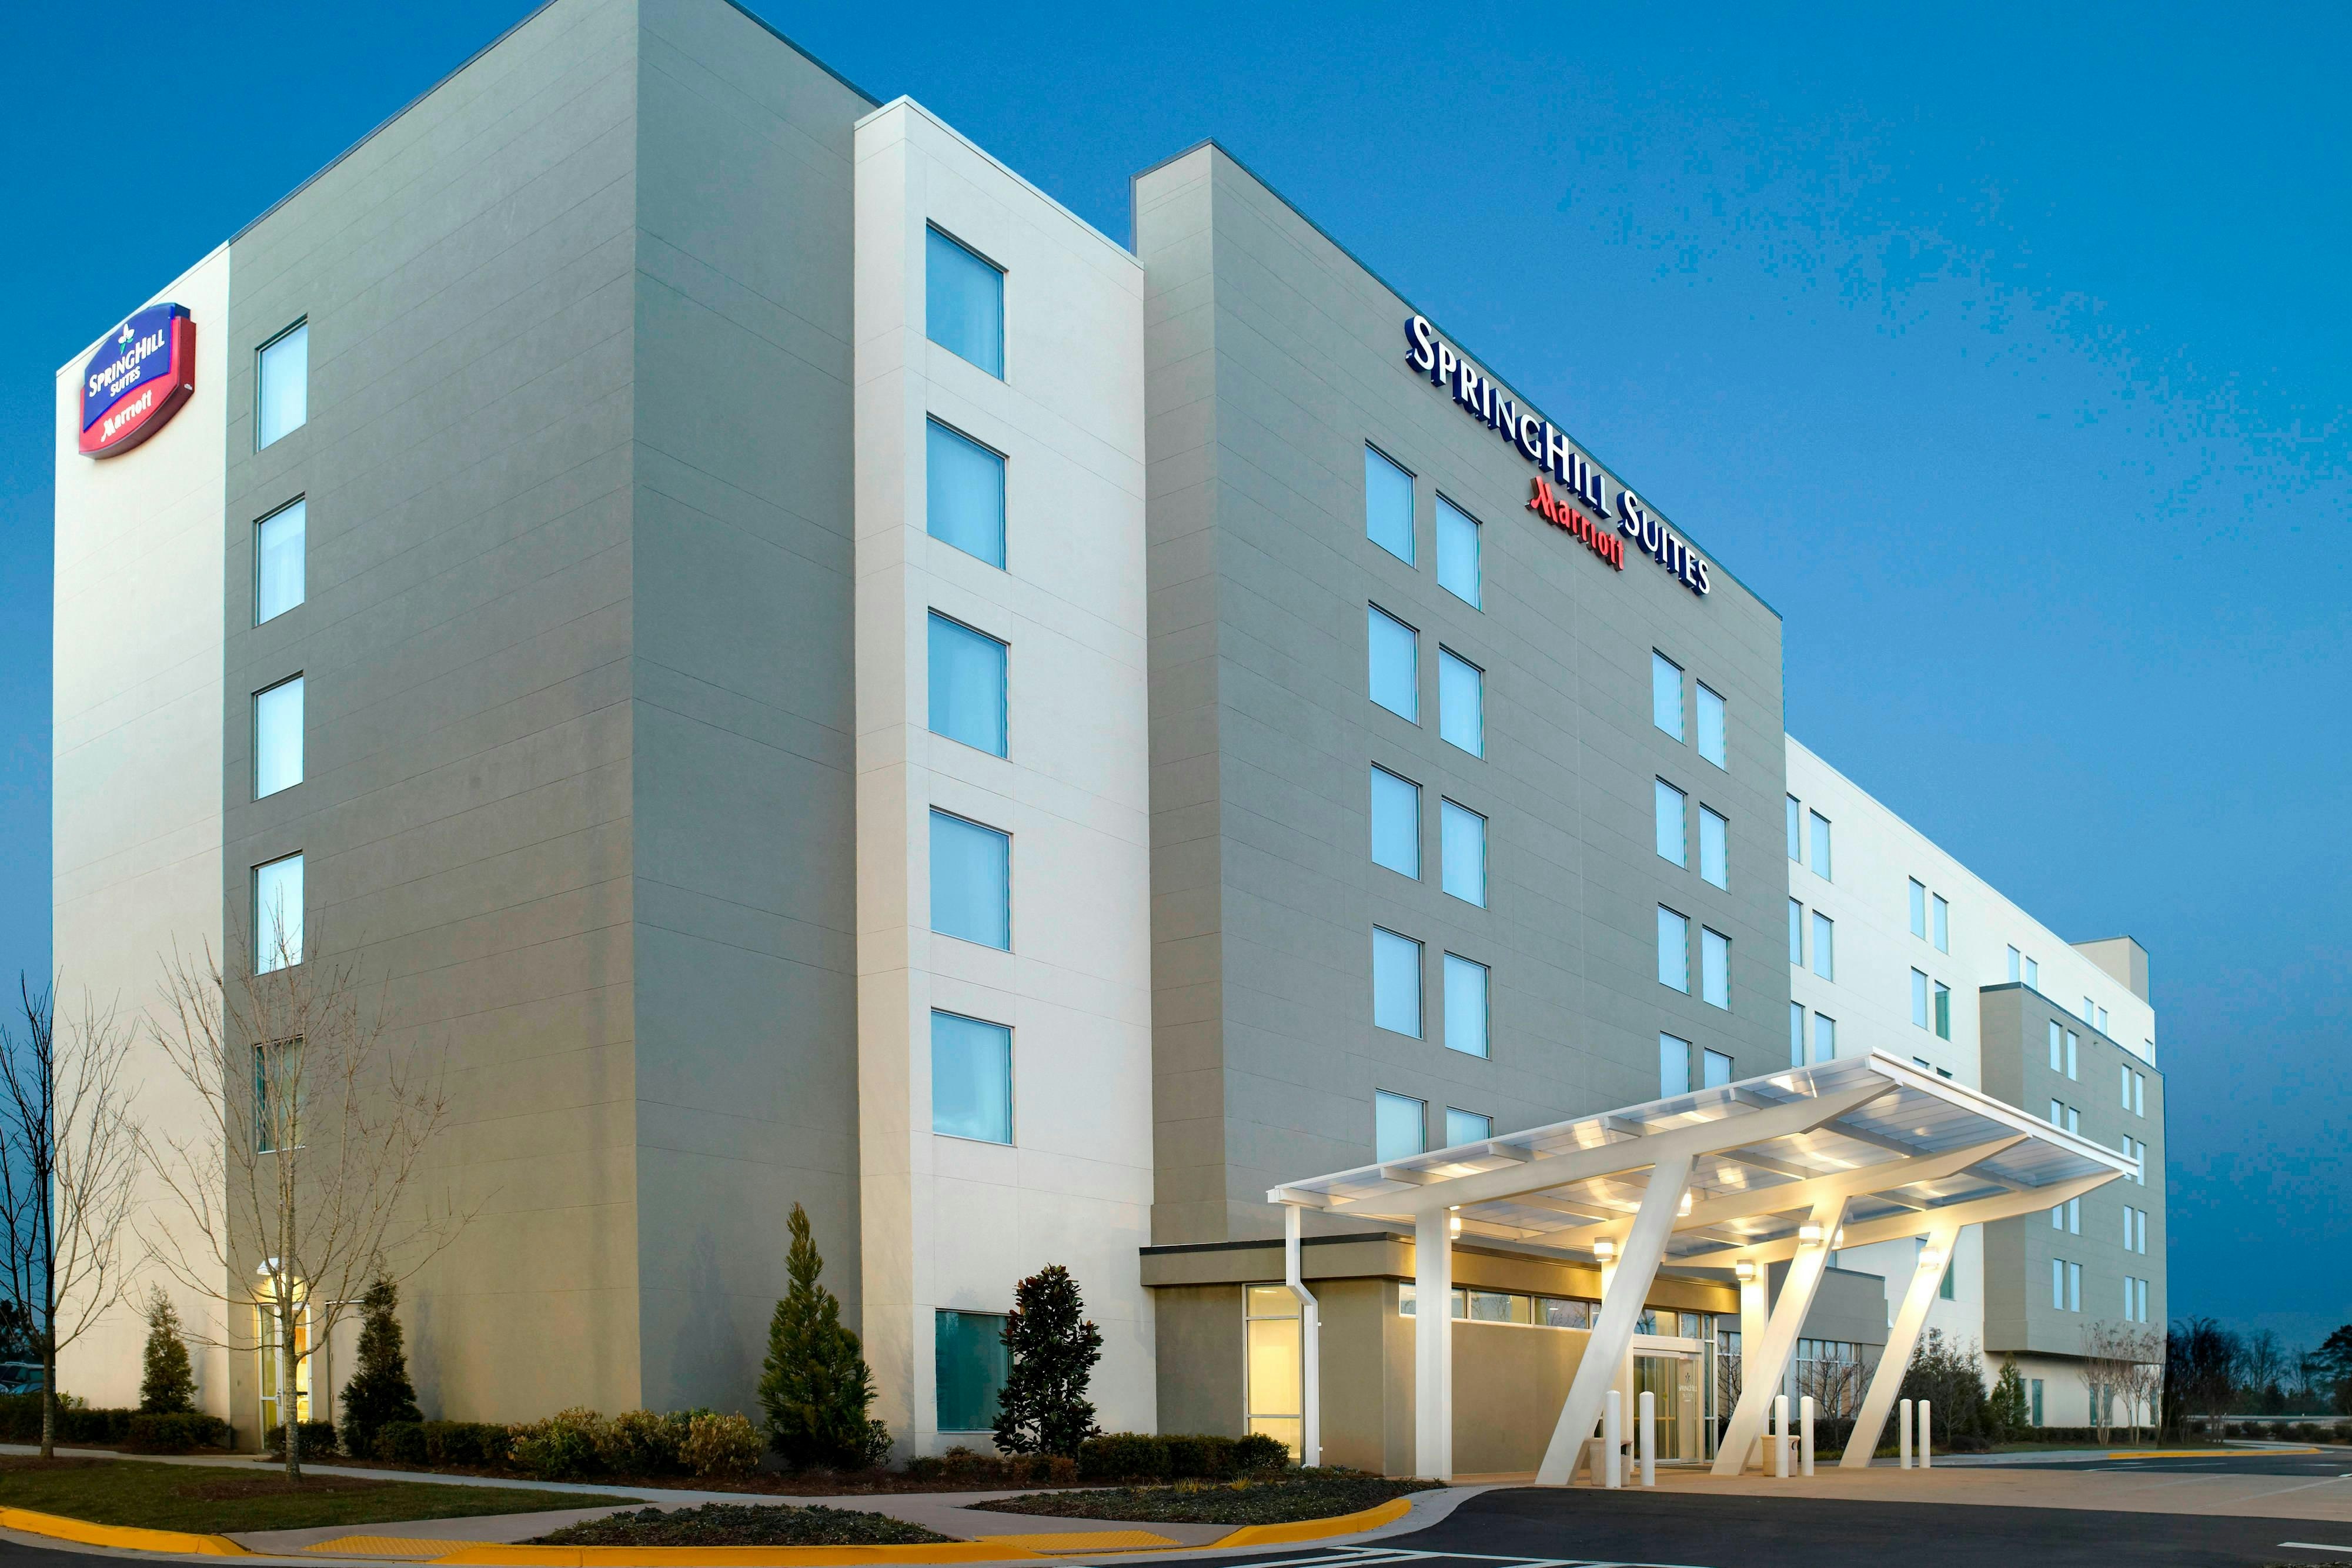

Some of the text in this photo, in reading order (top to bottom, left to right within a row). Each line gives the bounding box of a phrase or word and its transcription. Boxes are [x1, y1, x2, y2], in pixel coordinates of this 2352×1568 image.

[89, 329, 165, 397] SPRINGHILL
[110, 366, 141, 397] SUITES
[100, 389, 152, 442] Marriott
[1406, 315, 1710, 595] SPRINGHILL SUITES
[1529, 475, 1625, 571] Marriott
